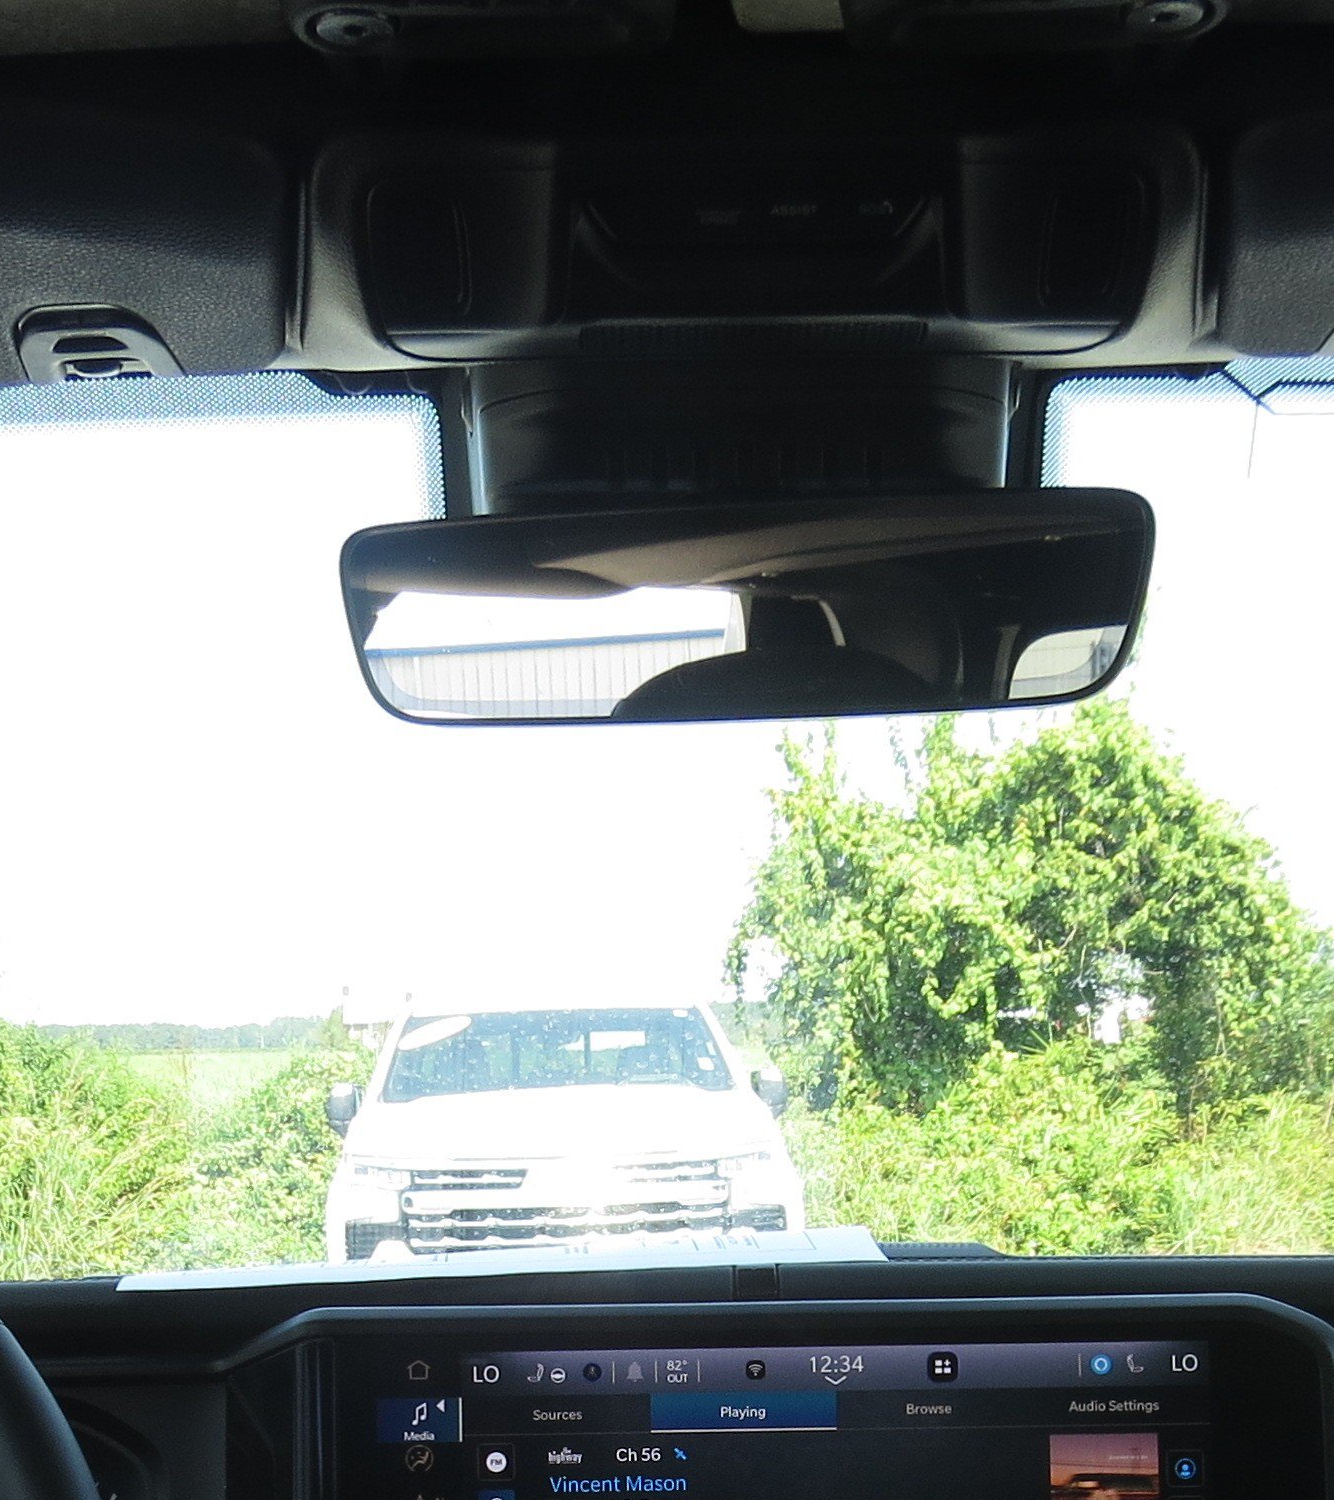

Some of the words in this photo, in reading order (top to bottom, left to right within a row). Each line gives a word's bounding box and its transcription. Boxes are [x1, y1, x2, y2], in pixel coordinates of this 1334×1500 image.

[666, 1359, 687, 1371] 82°
[809, 1355, 864, 1374] 12:34
[1171, 1354, 1199, 1373] LO
[472, 1365, 500, 1384] LO
[666, 1372, 688, 1384] OUT
[719, 1405, 767, 1421] Playing
[905, 1402, 952, 1415] Browse
[1069, 1400, 1107, 1412] Audio
[1108, 1399, 1160, 1414] Settings
[532, 1409, 583, 1421] Sources
[403, 1430, 435, 1441] Media
[616, 1448, 638, 1462] Ch
[640, 1448, 661, 1462] 56
[550, 1475, 620, 1492] Vincent
[626, 1475, 687, 1492] Mason
